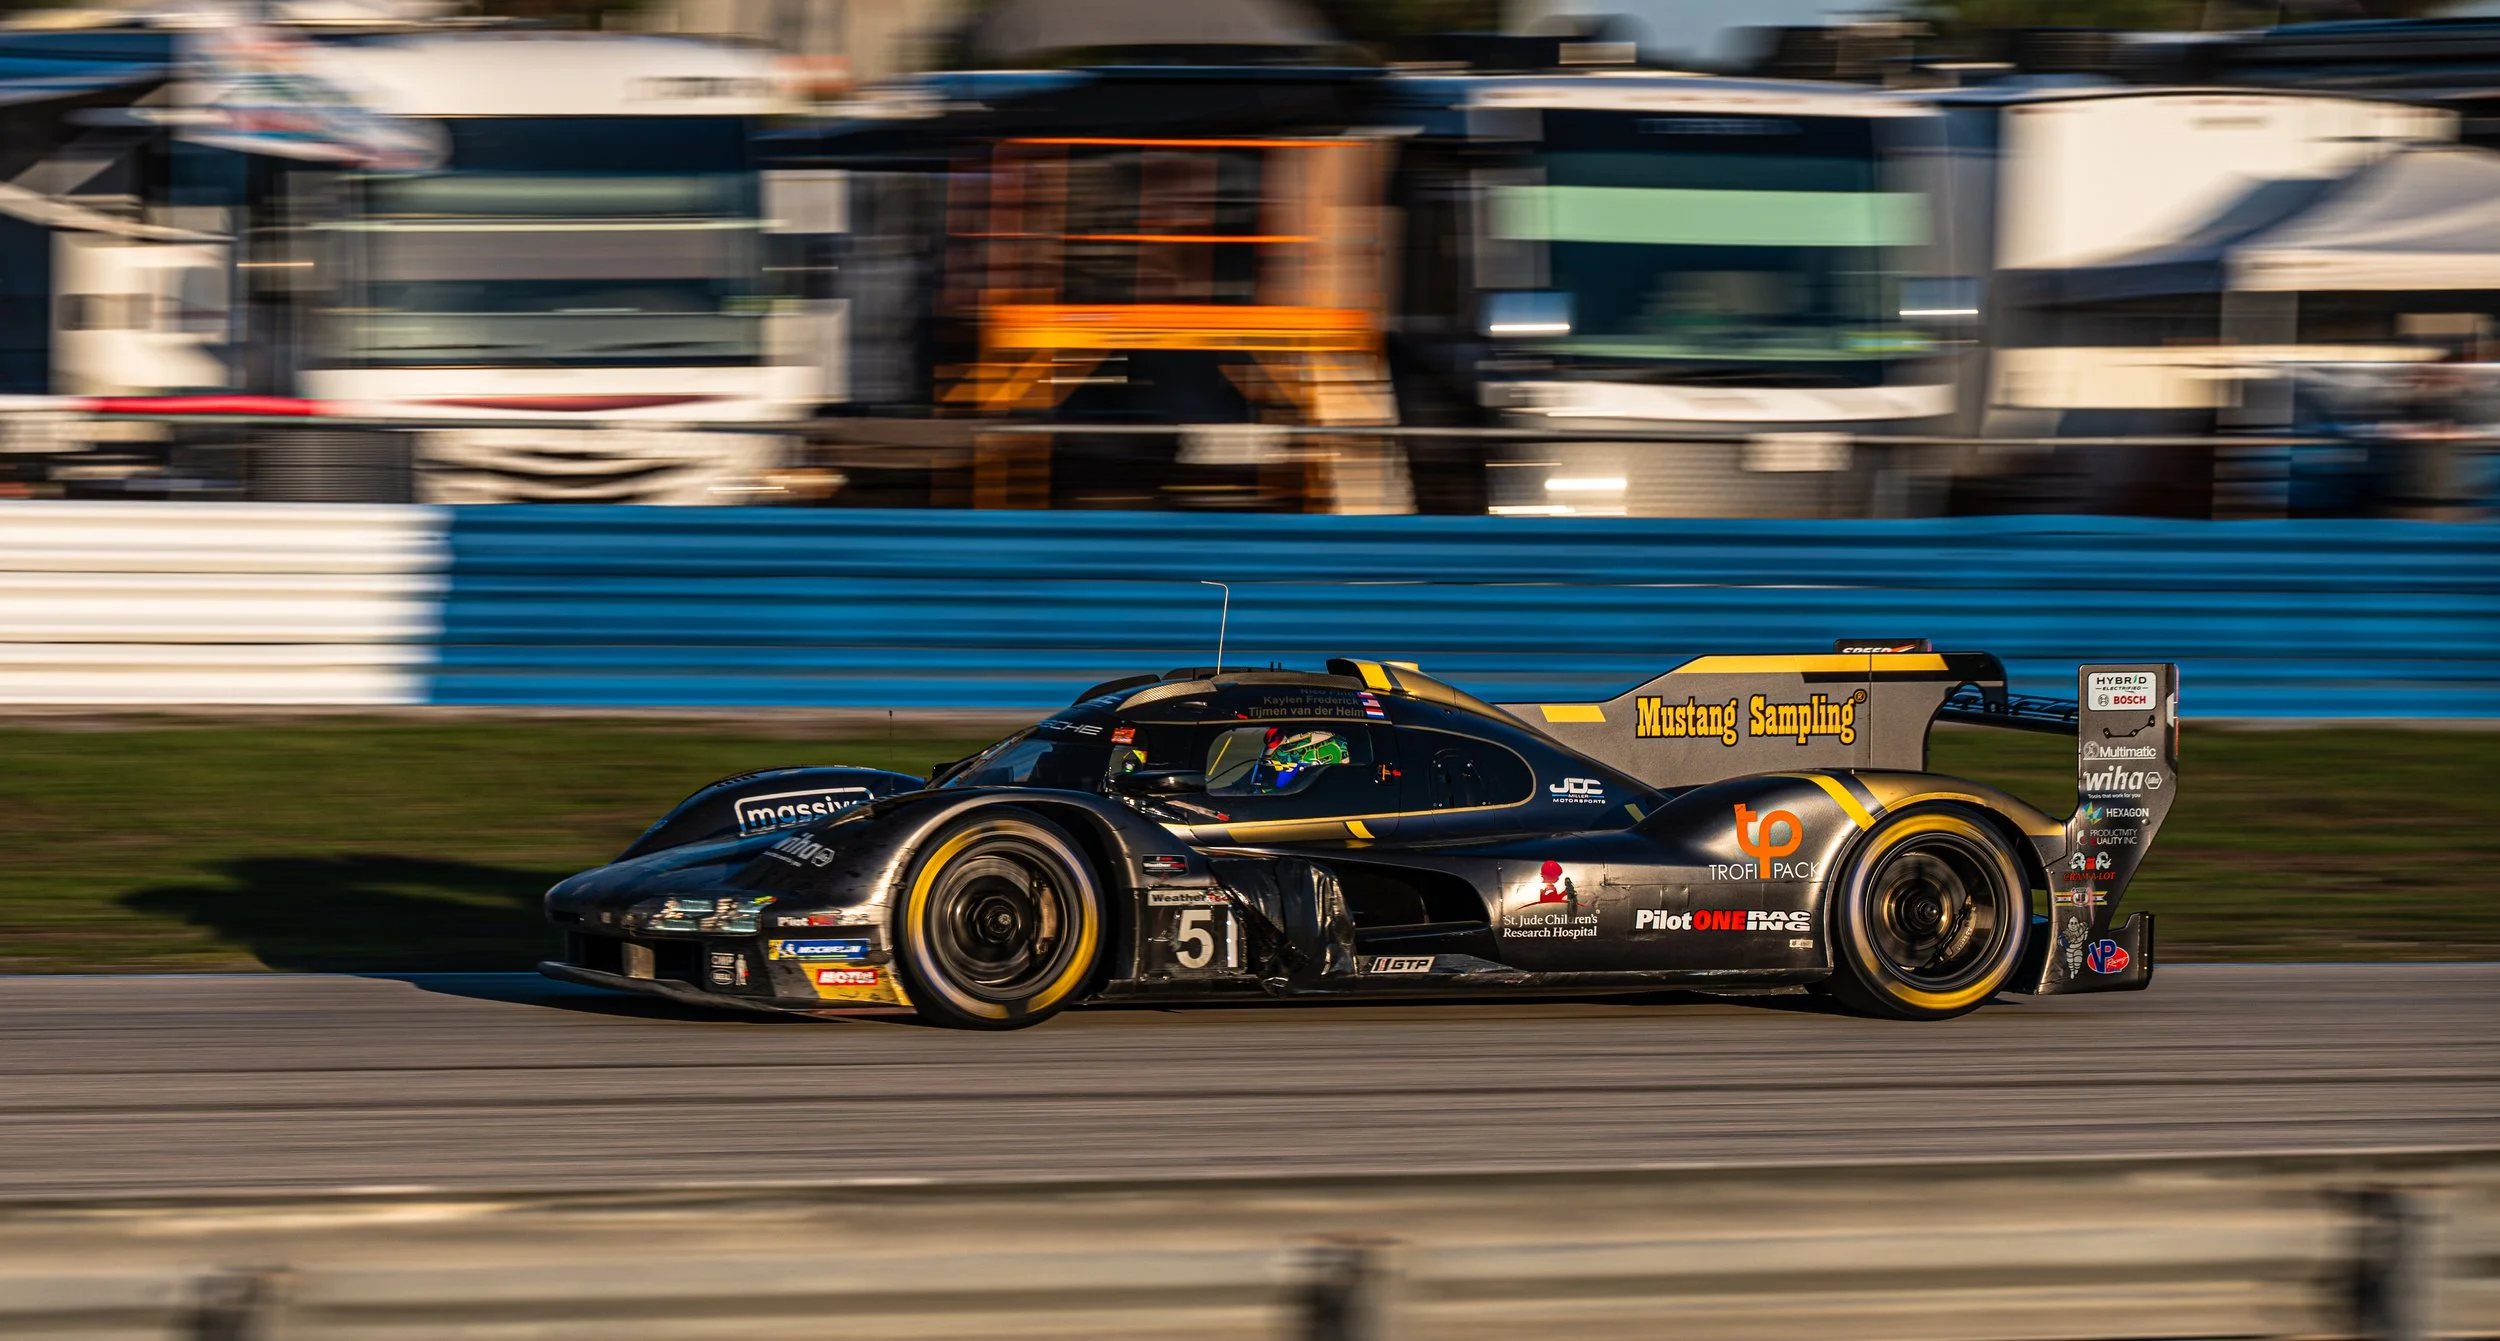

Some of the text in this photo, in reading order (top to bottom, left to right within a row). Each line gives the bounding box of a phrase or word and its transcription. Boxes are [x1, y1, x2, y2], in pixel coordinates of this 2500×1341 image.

[1263, 696, 1360, 706] Kaylen Frederick
[2113, 695, 2147, 705] BOSCH
[1248, 706, 1364, 718] Tijmen van der Helm
[1636, 694, 1738, 746] Mustang
[2100, 746, 2157, 758] Multimatic
[2083, 765, 2144, 791] wiha
[1549, 777, 1603, 794] JDC
[2106, 808, 2149, 818] HEXAGON
[2124, 837, 2138, 845] INC
[1708, 862, 1821, 880] TROFI PACK
[1503, 915, 1518, 926] St.
[1519, 914, 1543, 927] Jude
[1503, 926, 1597, 939] Research Hospital
[2088, 939, 2117, 973] VP
[1390, 959, 1430, 970] GTP
